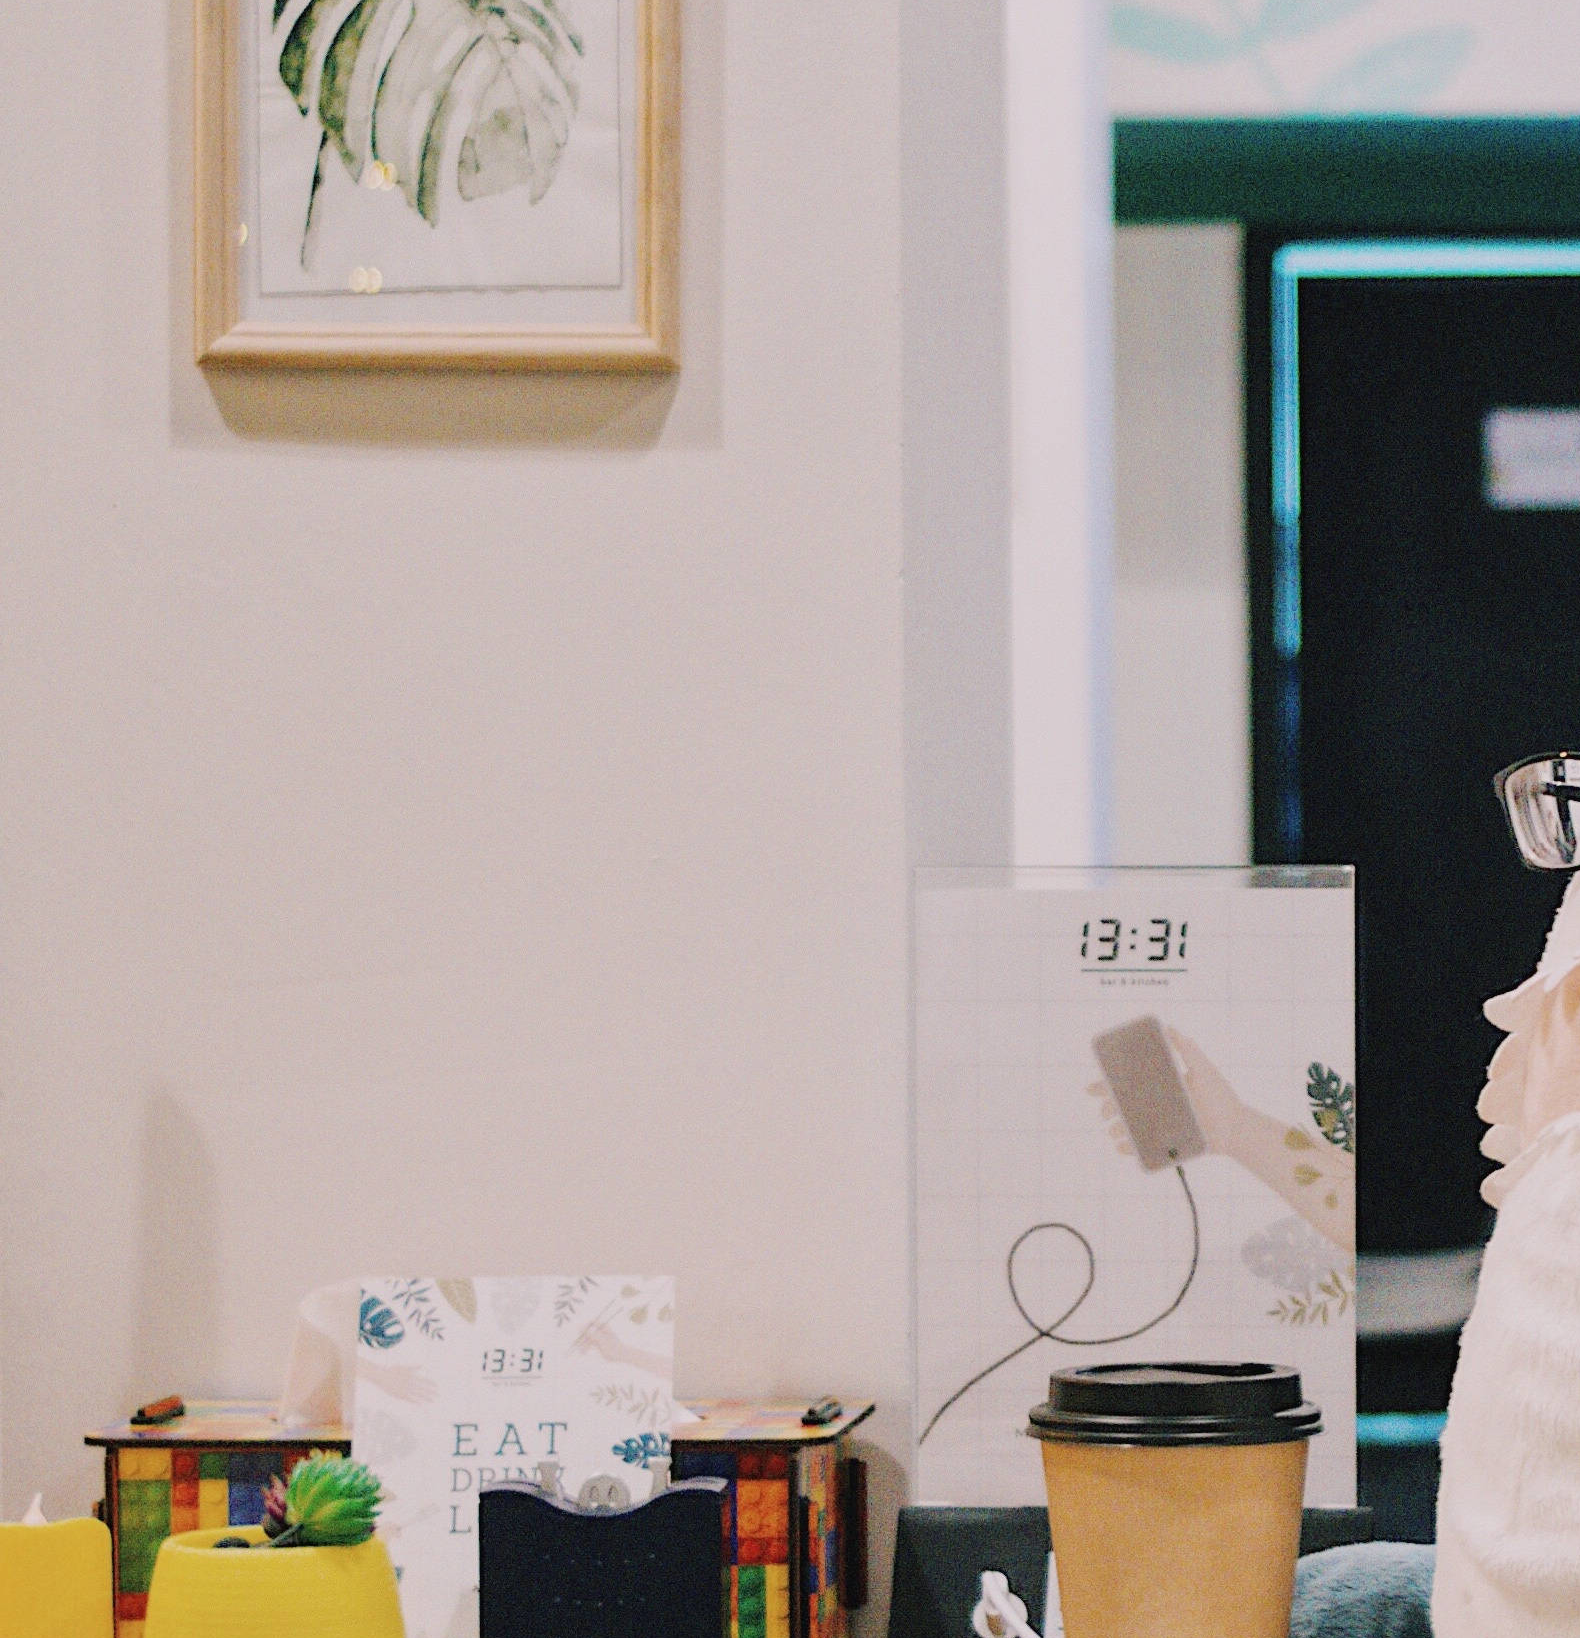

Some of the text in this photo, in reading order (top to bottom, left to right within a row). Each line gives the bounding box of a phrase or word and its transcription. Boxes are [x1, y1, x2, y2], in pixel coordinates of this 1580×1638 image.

[1081, 918, 1188, 961] 13:31
[482, 1348, 544, 1373] 13:31
[452, 1422, 568, 1456] EAT
